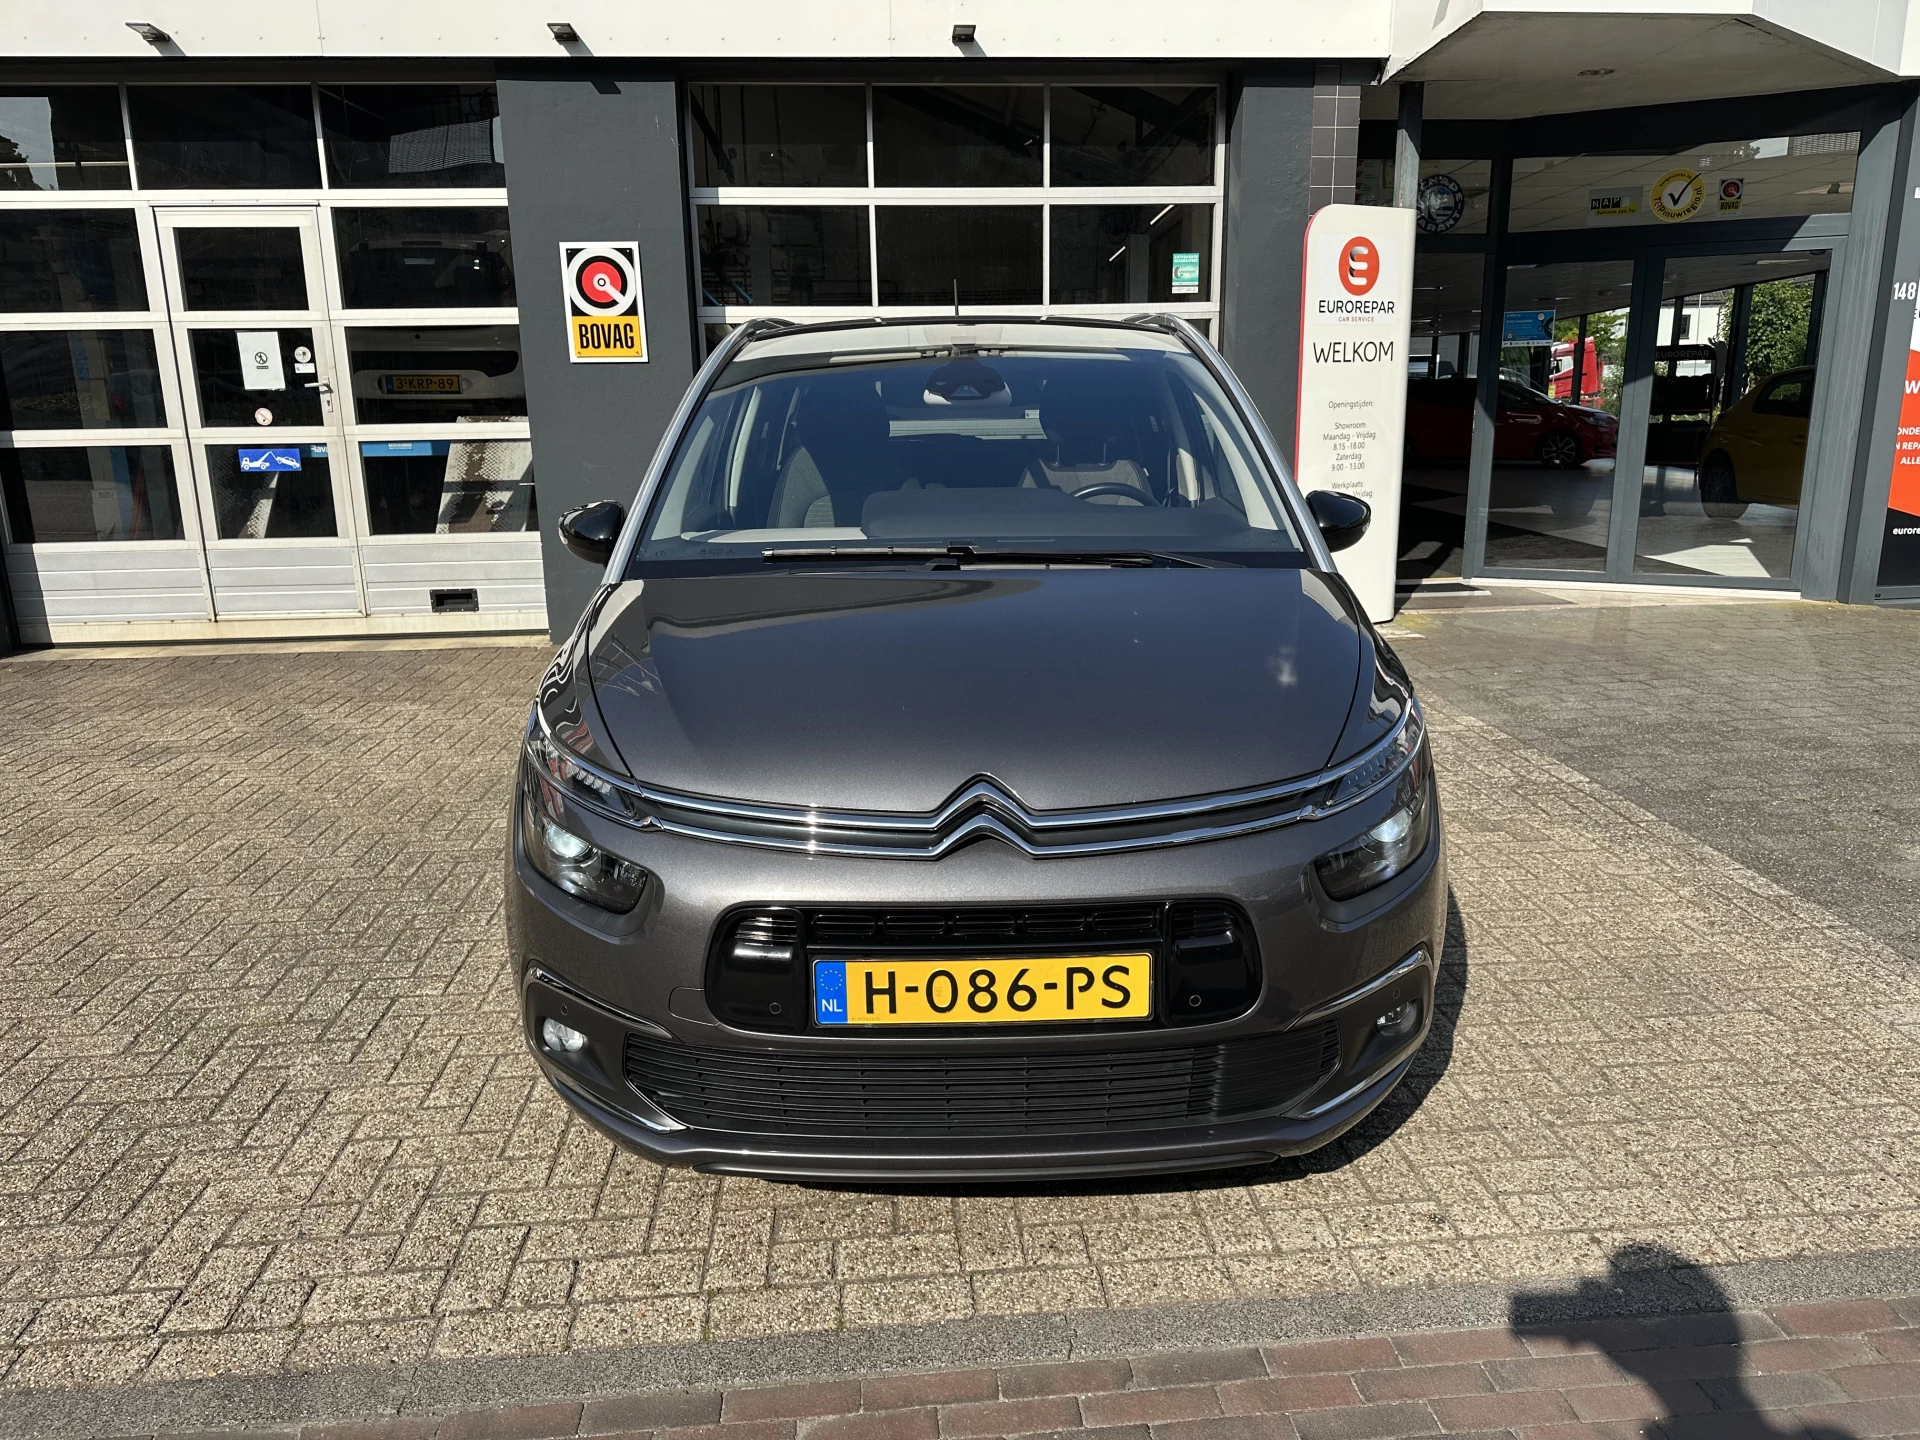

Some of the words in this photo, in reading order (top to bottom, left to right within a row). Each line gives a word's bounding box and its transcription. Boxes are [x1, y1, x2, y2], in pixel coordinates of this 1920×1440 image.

[1720, 201, 1739, 210] BOVAG
[1893, 281, 1917, 300] 148
[1318, 300, 1395, 314] EUROREPAR
[578, 323, 635, 349] BOVAG
[1313, 341, 1394, 363] WELKOM
[1655, 349, 1710, 359] EUROREPAR
[1328, 400, 1374, 409] Openingstijden:
[1334, 422, 1366, 430] Showroom
[1323, 433, 1351, 442] Maandag
[1356, 432, 1376, 440] Vrijdag
[1333, 443, 1346, 451] 8.15
[1336, 453, 1362, 461] Zaterdag
[1331, 463, 1344, 471] 9.00
[1349, 462, 1365, 470] 13.00
[1332, 481, 1363, 490] Werkplaats
[864, 965, 1131, 1014] H-086-PS
[822, 999, 843, 1012] NL
